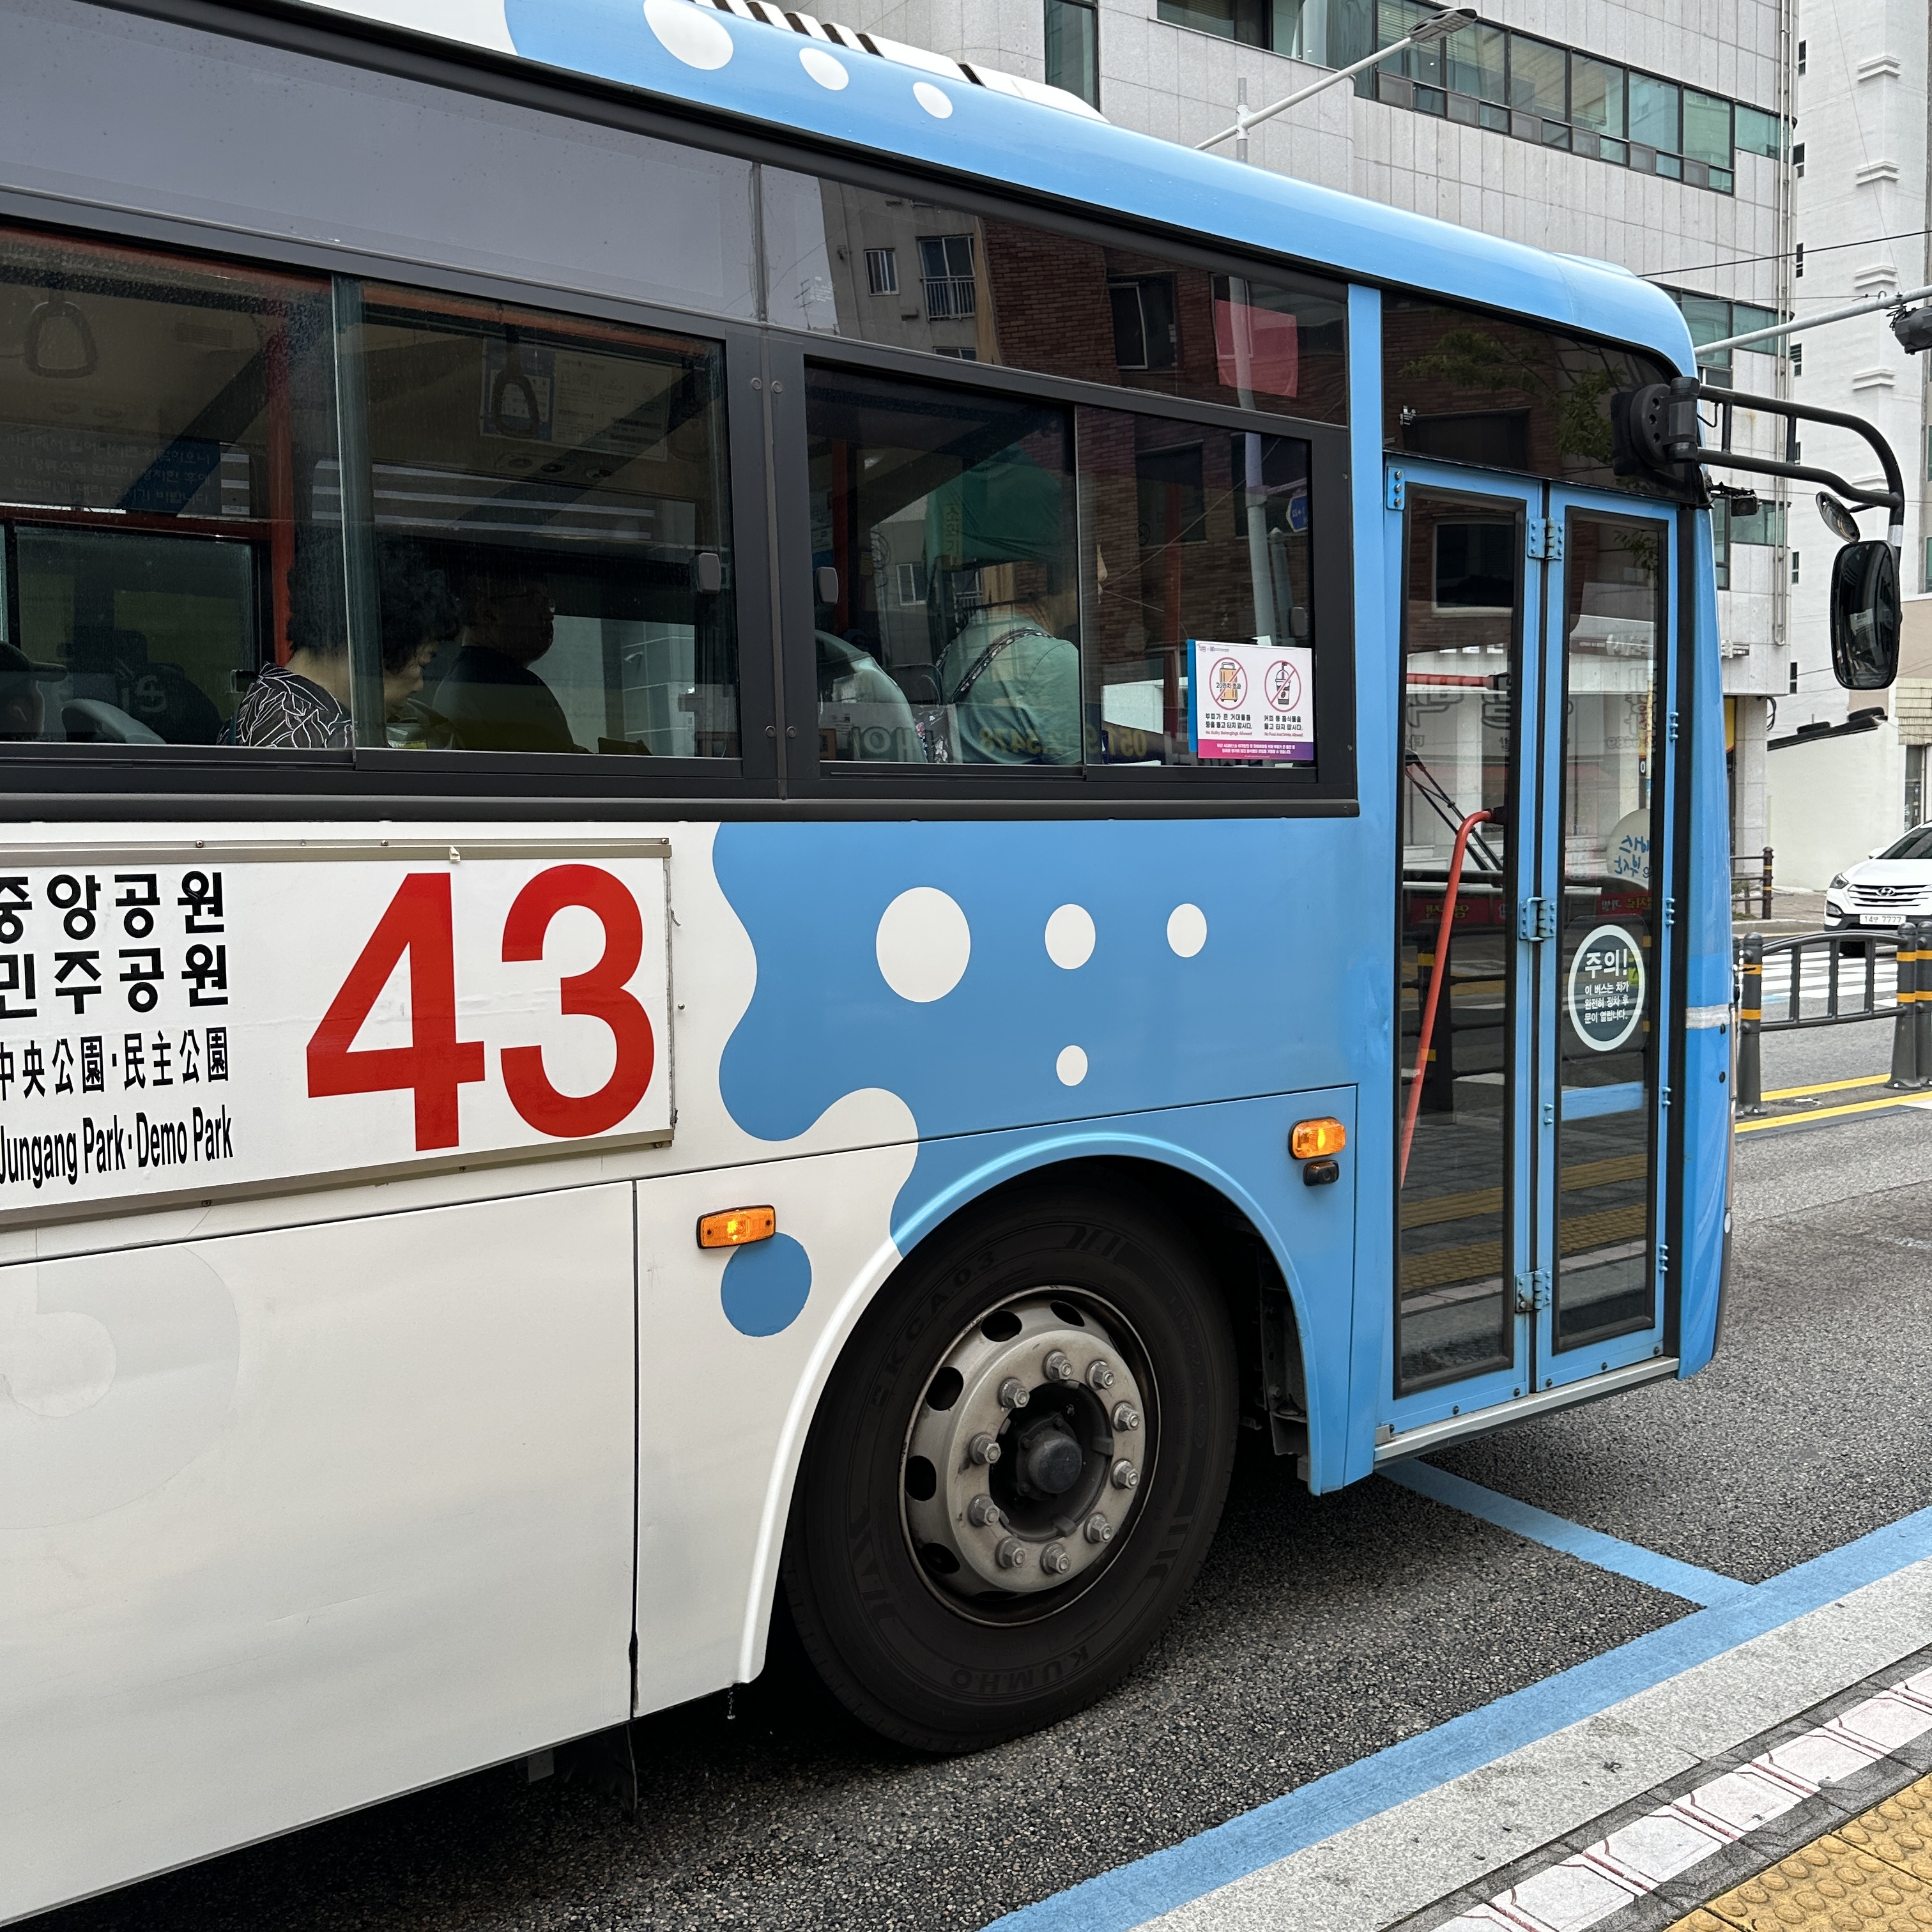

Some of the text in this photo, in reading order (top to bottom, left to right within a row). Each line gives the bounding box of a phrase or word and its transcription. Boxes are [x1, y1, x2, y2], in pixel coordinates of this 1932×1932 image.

[0, 871, 225, 944] 중앙공원
[0, 944, 229, 1019] 민주공원
[1584, 949, 1628, 979] 주의!
[1584, 981, 1629, 995] 이 버스는 차가
[307, 864, 654, 1151] 43
[1584, 997, 1604, 1011] 완전히
[1607, 995, 1620, 1008] 정차
[1584, 1008, 1628, 1025] 문이 열립니다.
[0, 1124, 76, 1189] Jungang
[192, 1104, 233, 1161] Park
[949, 1643, 1090, 1694] KUMHO
